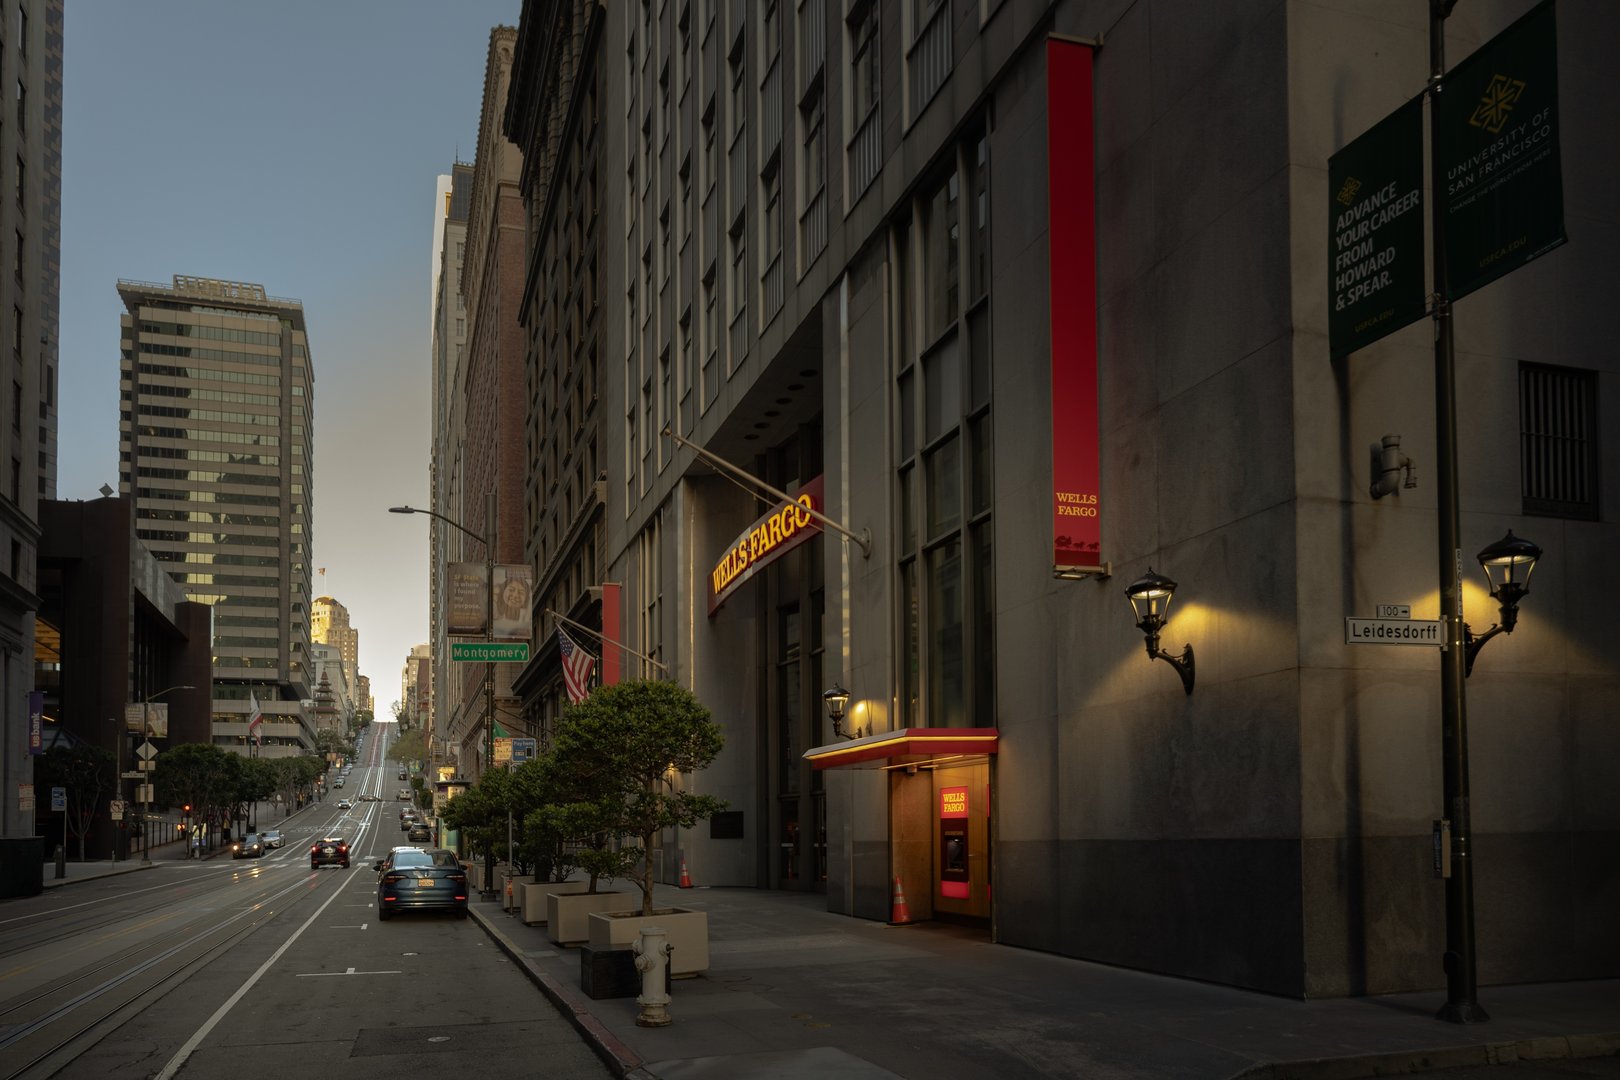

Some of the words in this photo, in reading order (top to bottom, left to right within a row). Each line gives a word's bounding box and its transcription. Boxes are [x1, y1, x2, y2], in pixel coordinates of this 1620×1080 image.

[1448, 122, 1527, 179] UNIVERSITY
[1531, 107, 1550, 127] OF
[1448, 173, 1474, 195] SAN
[1478, 124, 1551, 178] FRANCISCO
[1449, 193, 1476, 214] CHANGE
[1489, 172, 1512, 192] WORLD
[1512, 159, 1533, 176] FROM
[1336, 181, 1398, 232] ADVANCE
[1336, 220, 1370, 251] YOUR
[1370, 189, 1420, 231] CAREER
[1336, 237, 1373, 272] FROM
[1336, 246, 1396, 292] HOWARD
[1336, 293, 1346, 311] &
[1347, 270, 1393, 306] SPEAR.
[1056, 492, 1097, 504] WELLS
[1057, 505, 1097, 517] FARGO
[713, 540, 748, 594] WELLS
[748, 493, 812, 562] FARGO
[1383, 606, 1398, 616] 100
[1353, 623, 1437, 639] Leidesdorff
[453, 648, 527, 660] Montgomery
[943, 792, 965, 802] WELLS
[943, 803, 965, 812] FARGO
